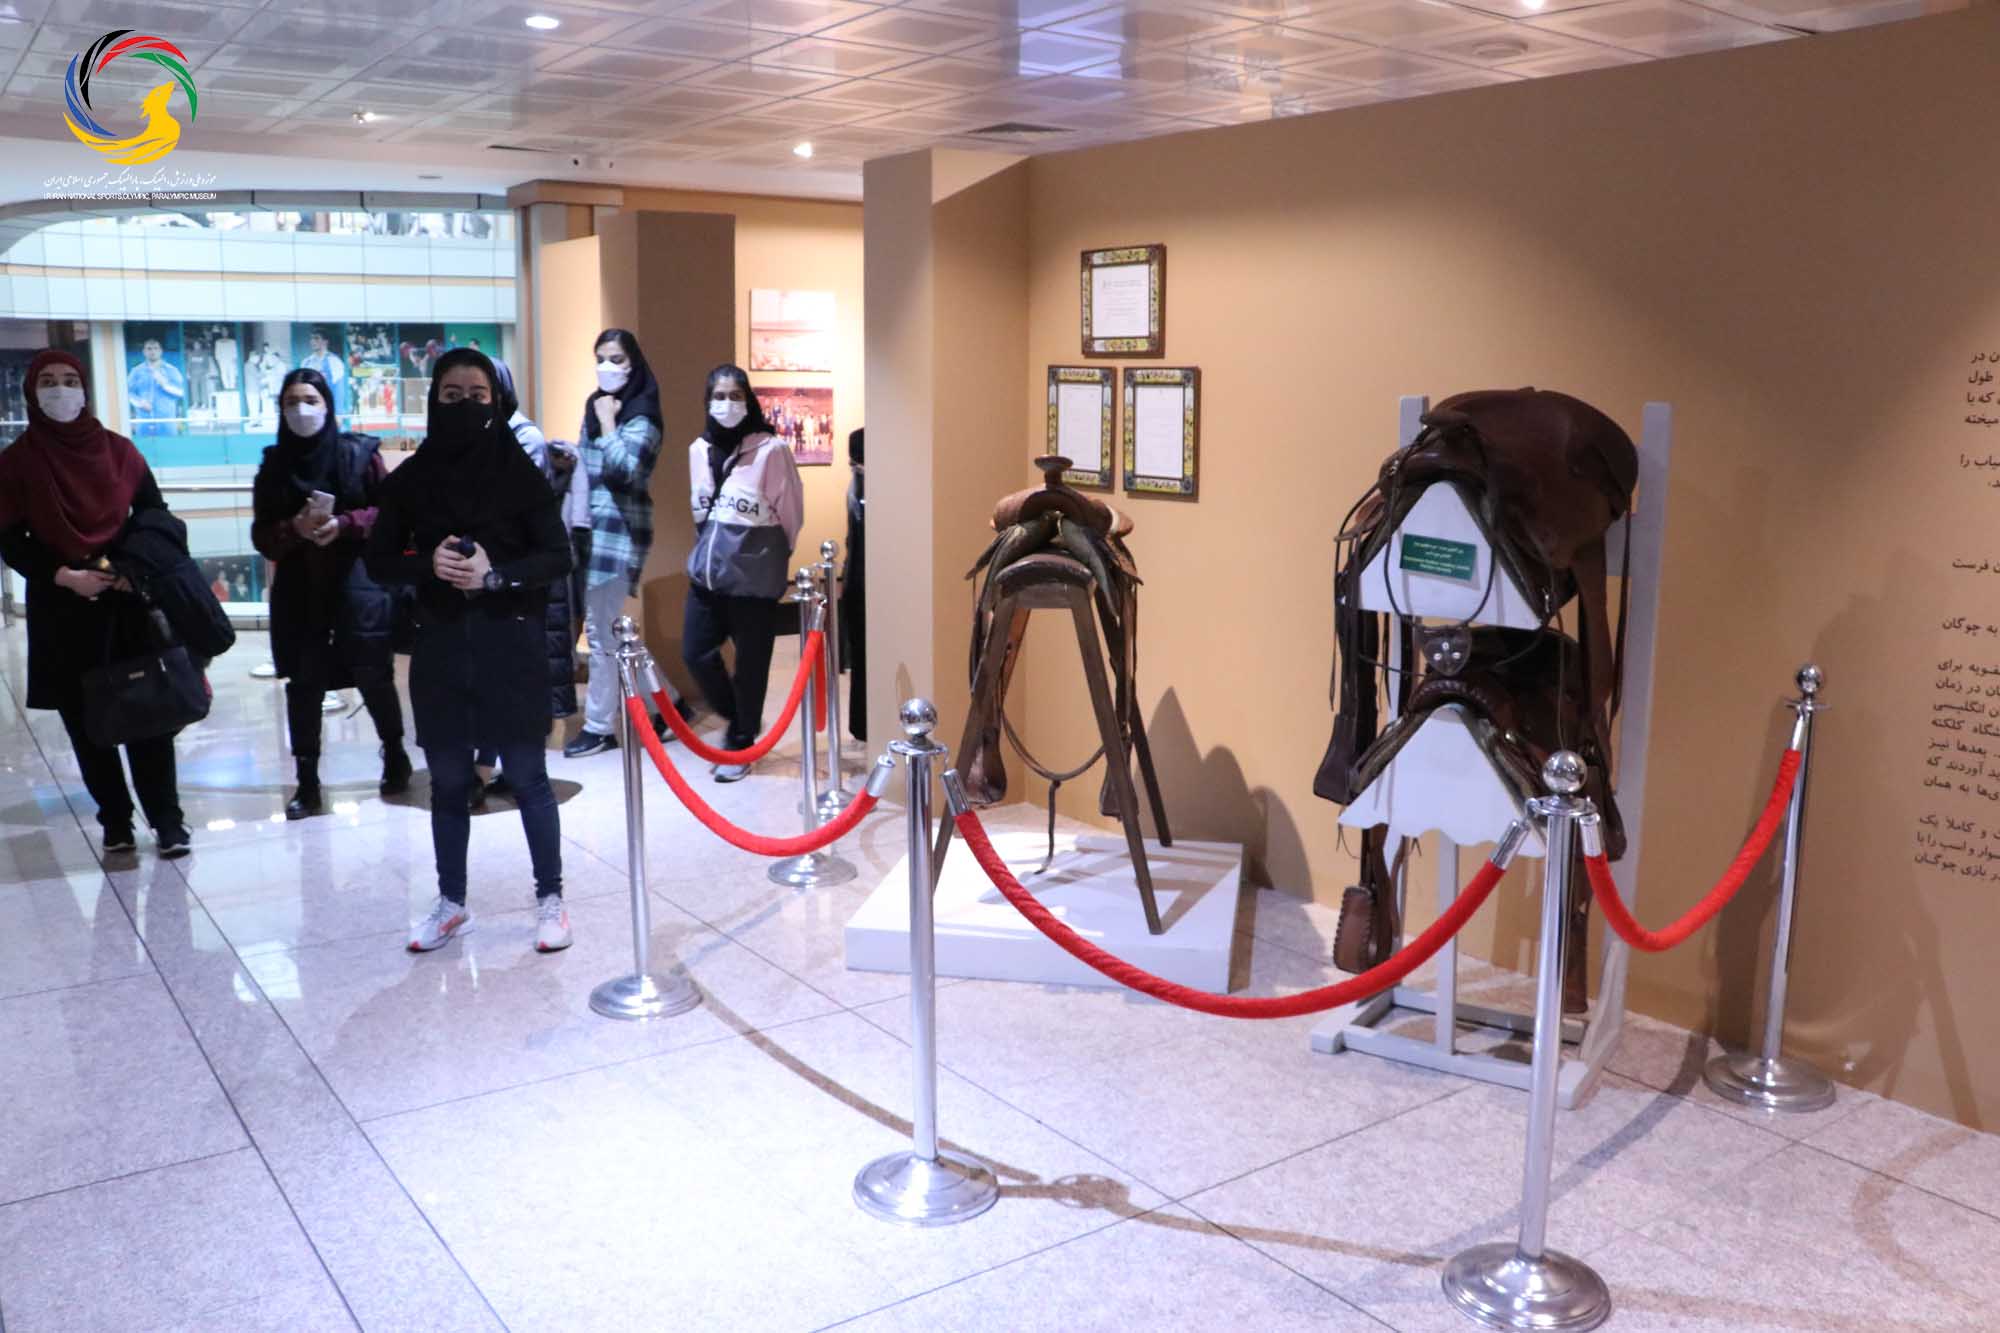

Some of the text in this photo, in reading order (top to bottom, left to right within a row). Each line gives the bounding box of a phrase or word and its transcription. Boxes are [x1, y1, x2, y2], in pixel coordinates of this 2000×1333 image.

[1968, 370, 1994, 385] طول
[1937, 658, 1963, 672] برای
[1935, 677, 1962, 693] زمان
[1923, 775, 1952, 790] همان
